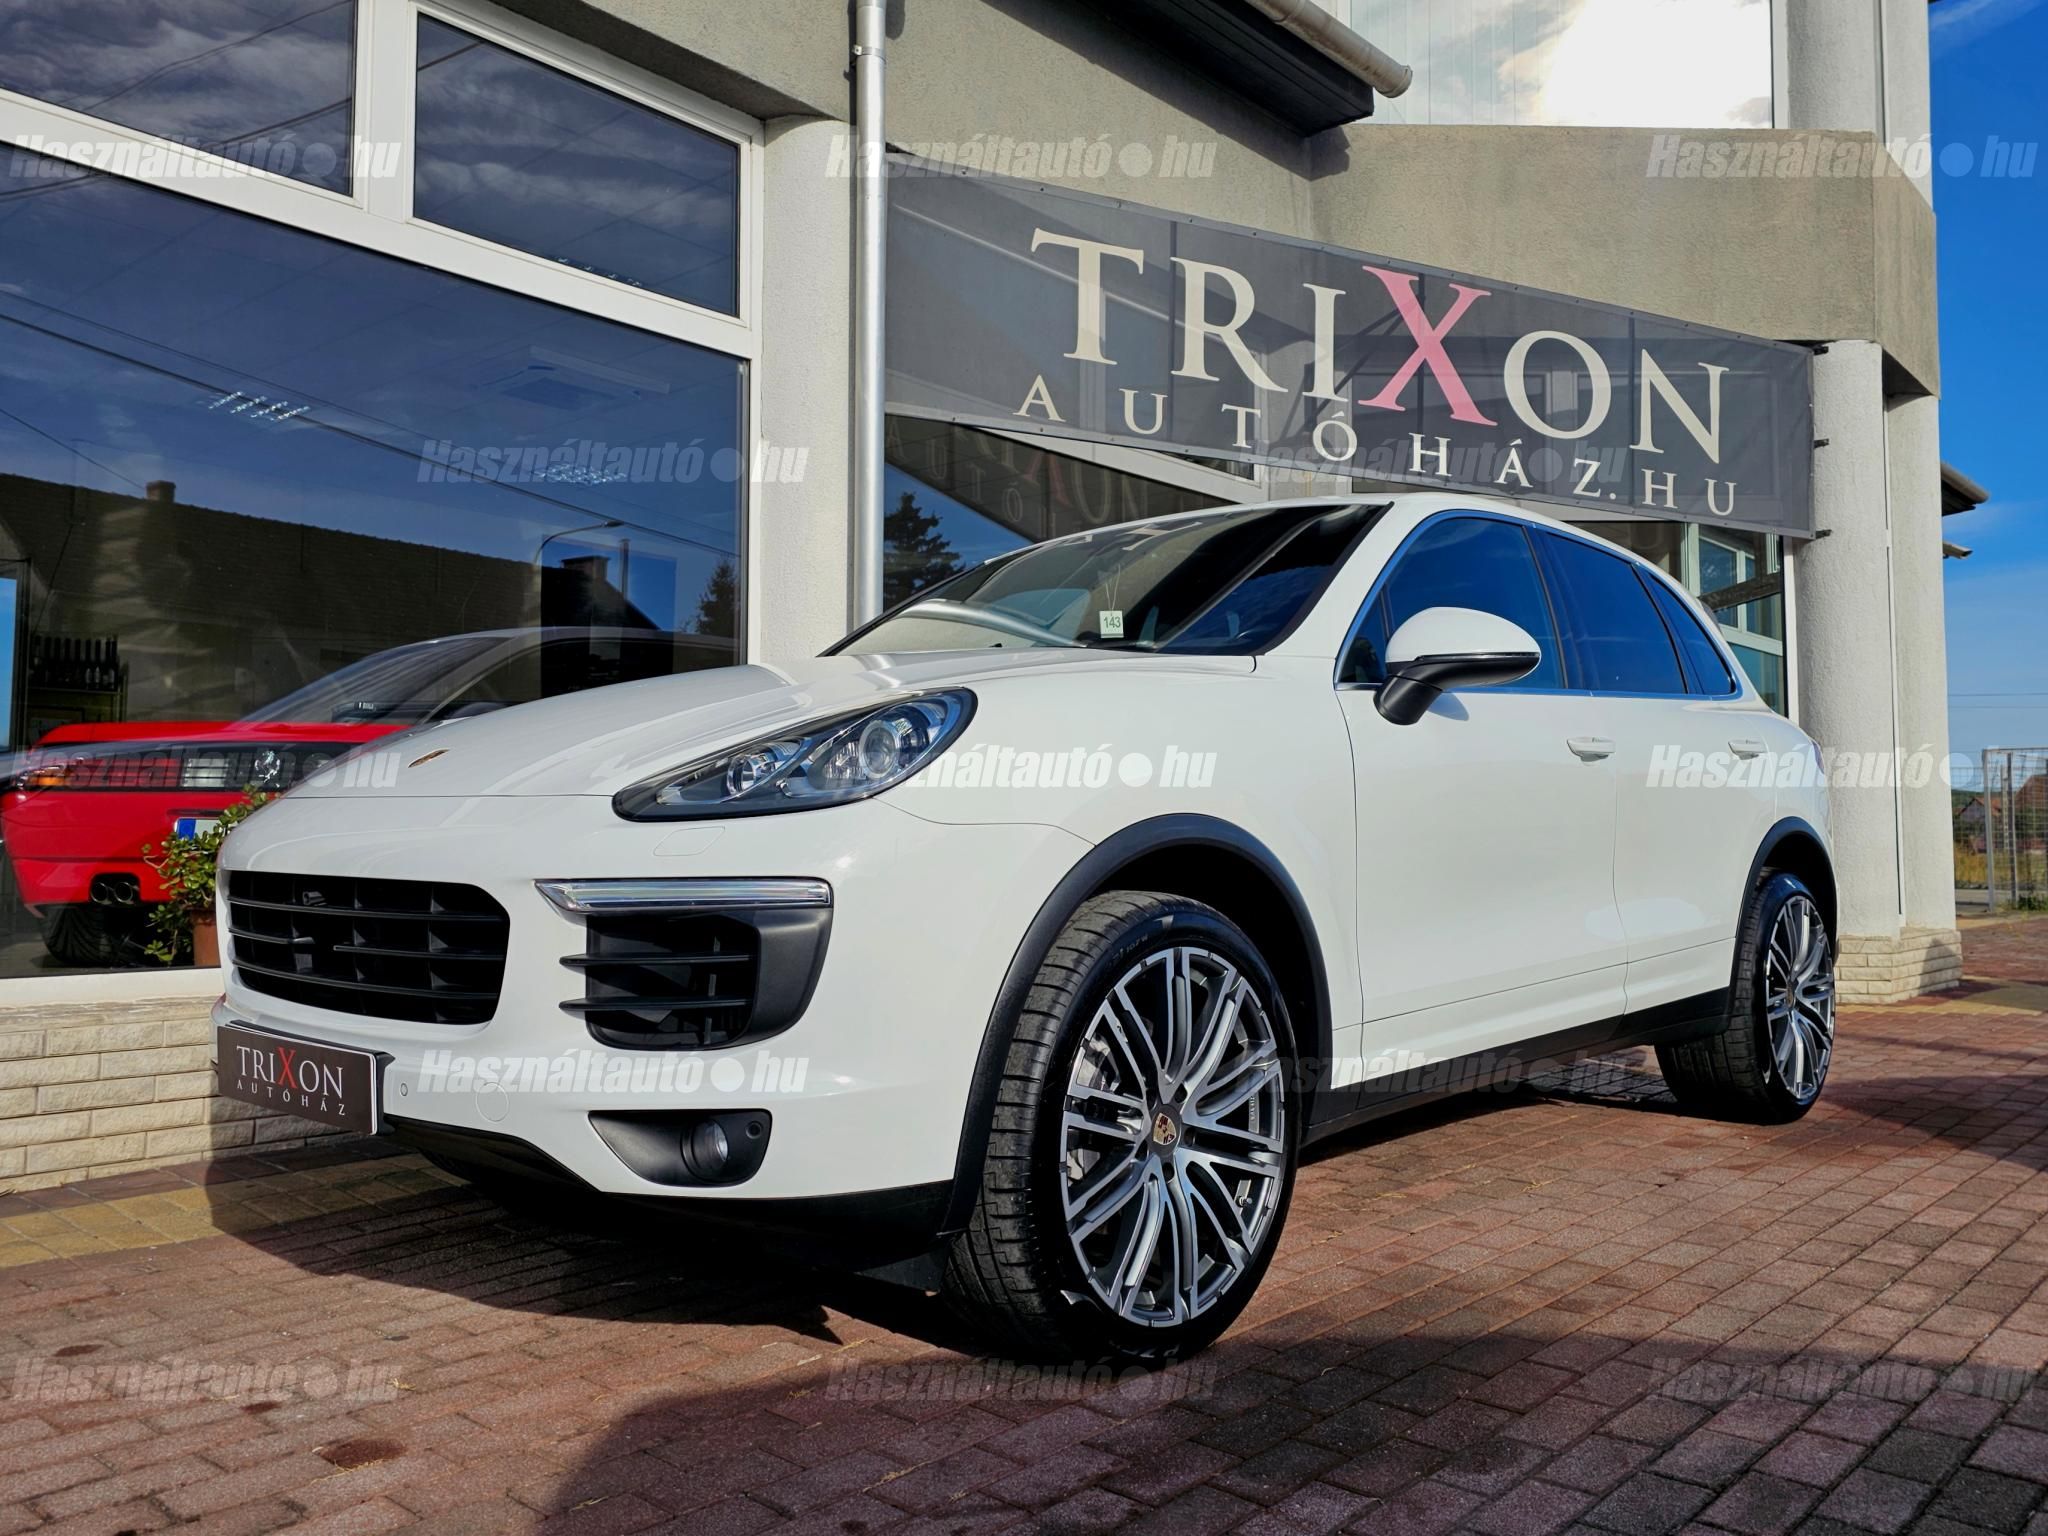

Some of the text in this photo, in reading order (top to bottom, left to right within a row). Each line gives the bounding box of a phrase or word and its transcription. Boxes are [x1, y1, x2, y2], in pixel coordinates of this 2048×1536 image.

[1030, 227, 1729, 464] TRIXON
[1103, 616, 1121, 629] 143
[236, 1045, 343, 1099] TRIXON
[237, 1079, 345, 1116] AUTÓHÁZ
